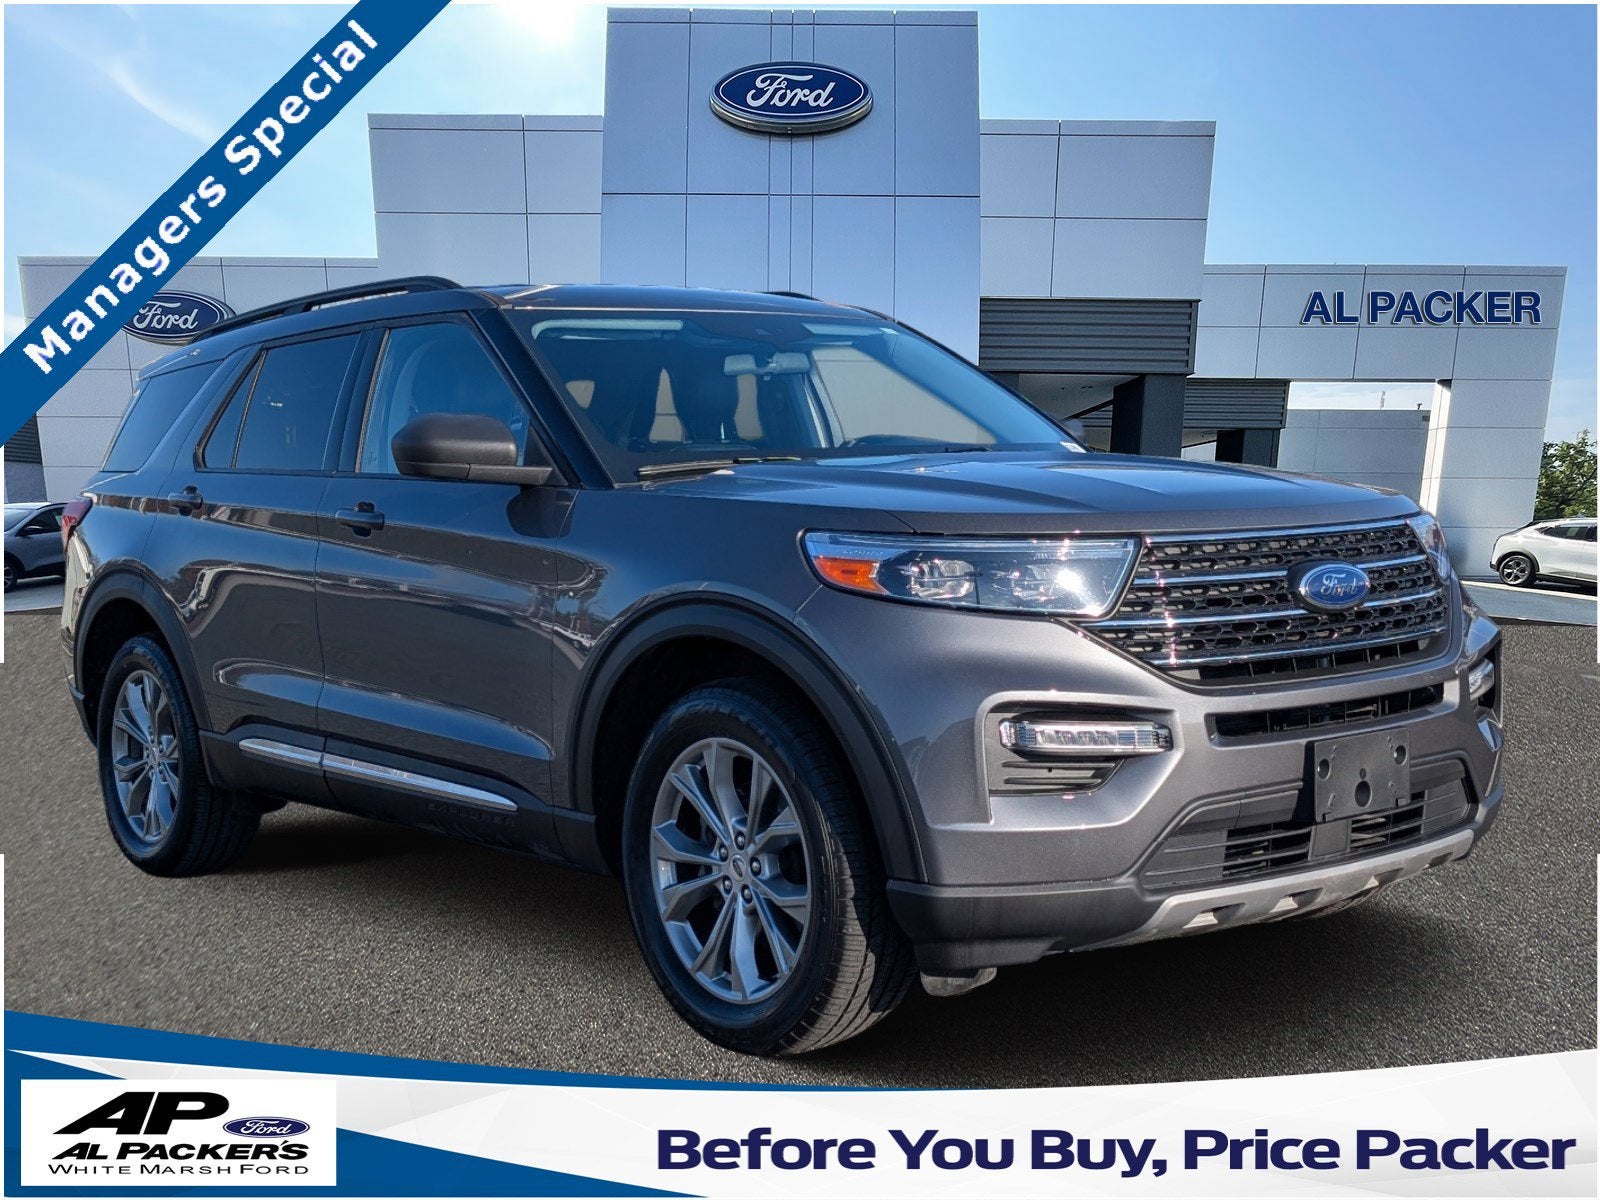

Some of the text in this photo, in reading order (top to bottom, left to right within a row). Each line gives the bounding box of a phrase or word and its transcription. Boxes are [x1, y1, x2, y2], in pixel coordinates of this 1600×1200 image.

[746, 73, 836, 107] Ford
[132, 301, 199, 329] Ford
[1301, 289, 1542, 325] AL PACKER
[1320, 573, 1360, 597] Ford
